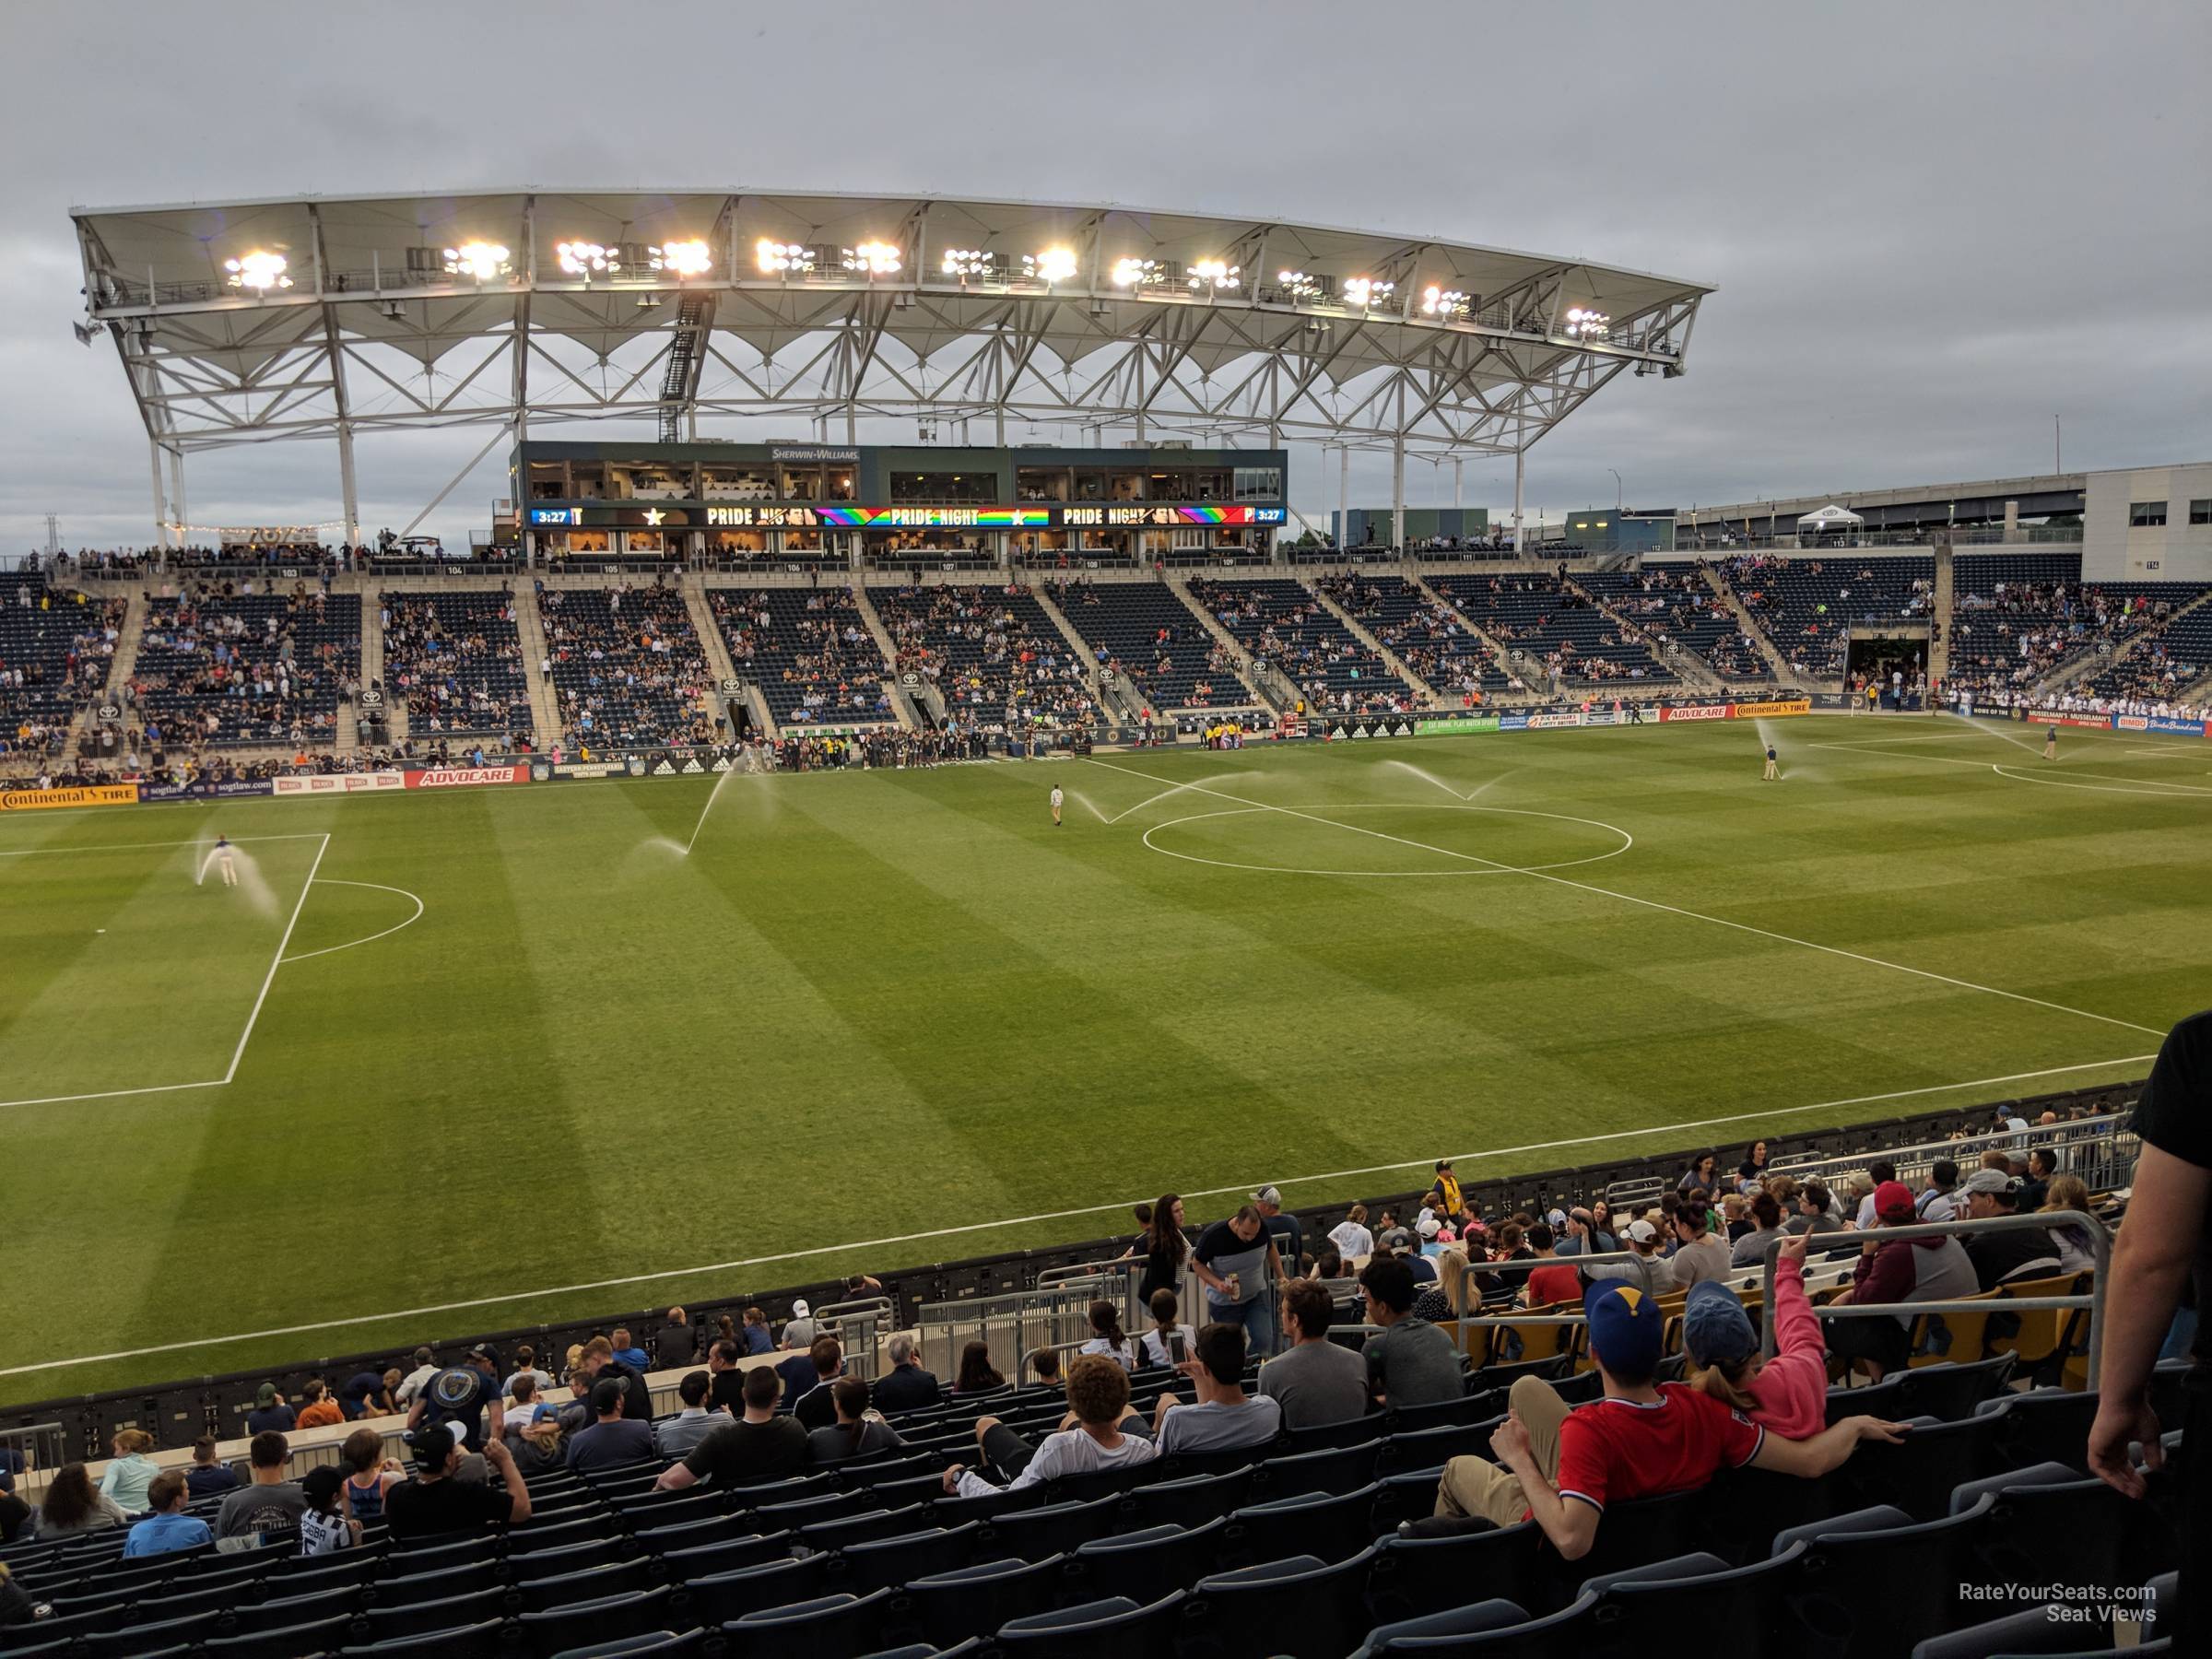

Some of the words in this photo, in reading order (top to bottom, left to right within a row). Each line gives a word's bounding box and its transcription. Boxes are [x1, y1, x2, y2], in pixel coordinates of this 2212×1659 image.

[538, 512, 566, 523] 3:27
[707, 508, 752, 525] PRIDE
[891, 509, 934, 525] PRIDE
[940, 509, 979, 525] NIGHT
[1064, 508, 1102, 524] PRIDE
[1109, 508, 1146, 524] NIGHT
[1258, 511, 1280, 521] 3:27
[282, 569, 297, 577] 103
[448, 566, 462, 574] 104
[605, 566, 618, 574] 105
[1668, 706, 1726, 720] ADVOCARE
[1737, 703, 1781, 716] Continental
[1973, 707, 1989, 715] HOME
[2029, 710, 2067, 719] MUSSELMAN'S
[2070, 713, 2112, 723] MUSSELMAN'S
[419, 767, 515, 786] ADVOCARE
[218, 781, 271, 793] sogtlaw.com
[3, 789, 85, 808] Continental
[102, 789, 133, 800] TIRE
